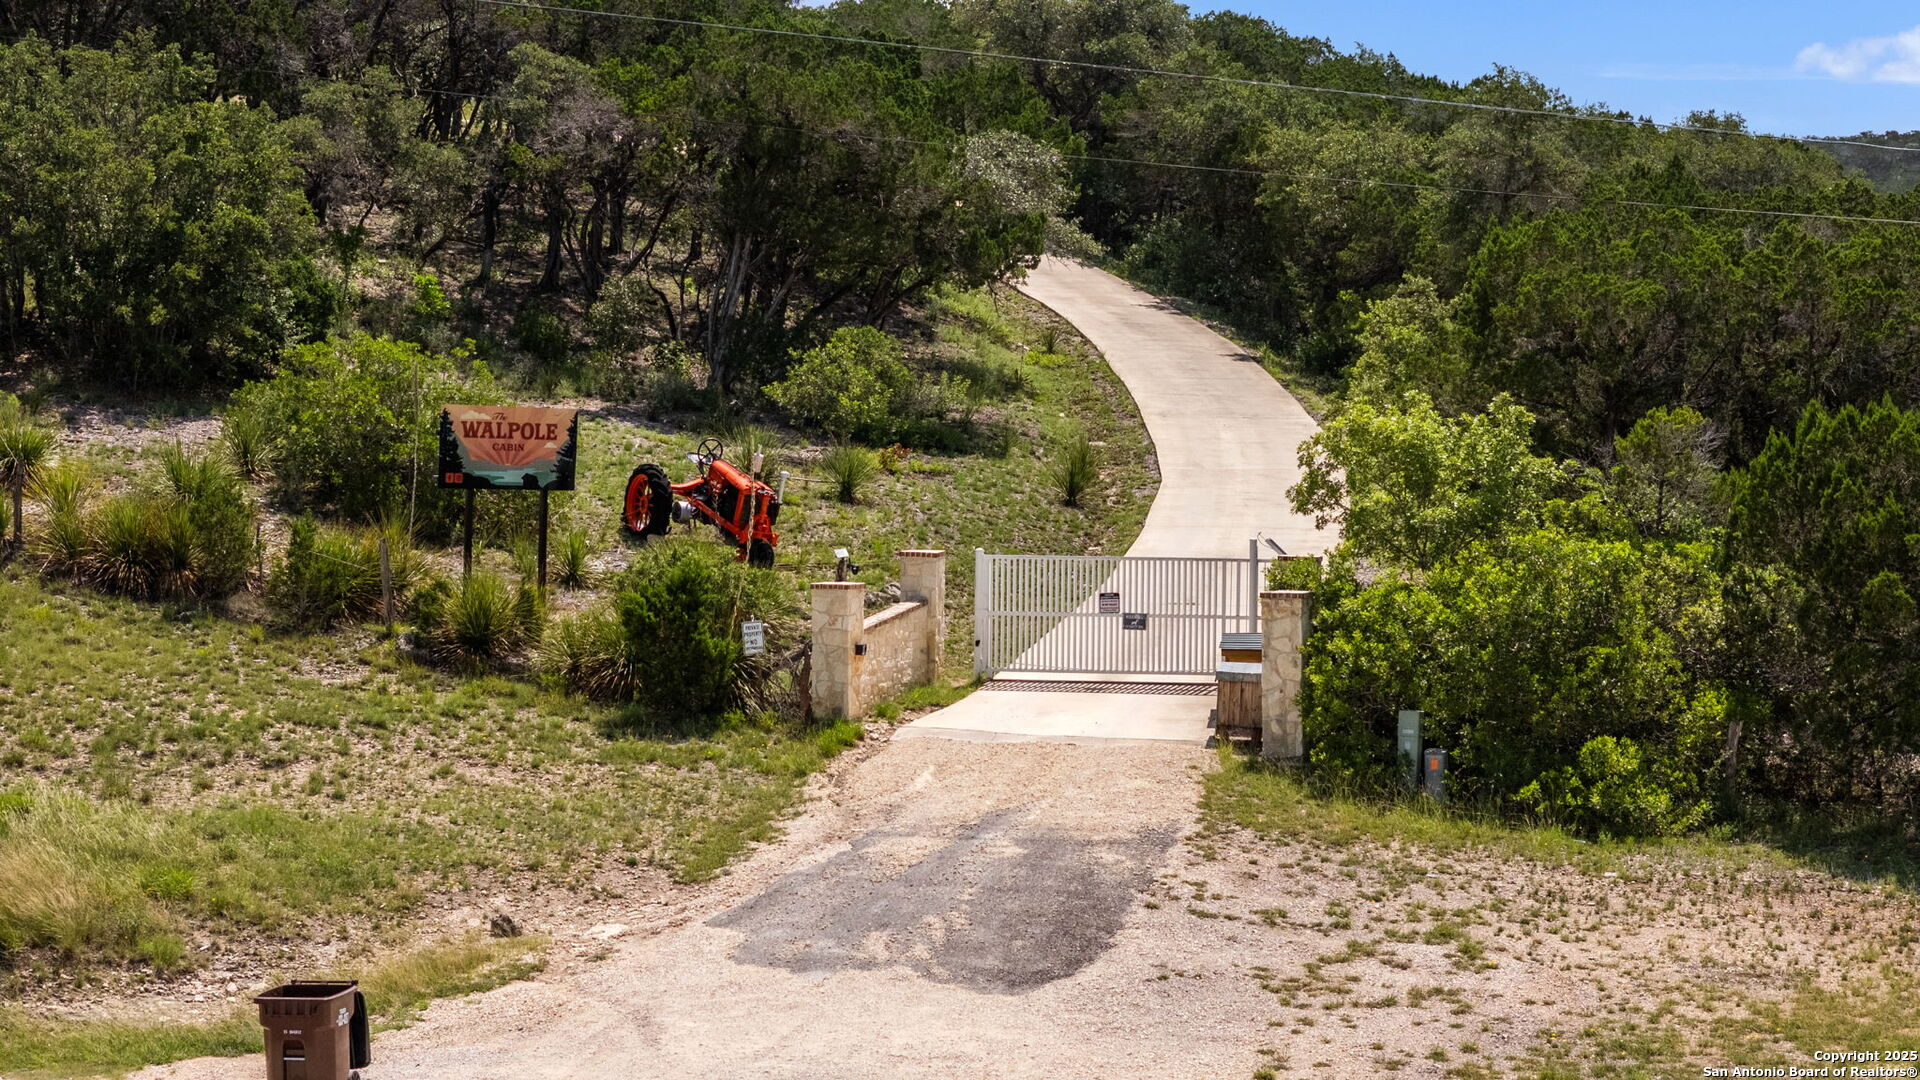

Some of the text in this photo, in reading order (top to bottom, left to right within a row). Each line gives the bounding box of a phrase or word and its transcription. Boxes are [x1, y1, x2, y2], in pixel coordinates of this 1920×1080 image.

[492, 412, 507, 421] The
[461, 420, 558, 441] WALPOLE
[492, 442, 525, 452] CABIN
